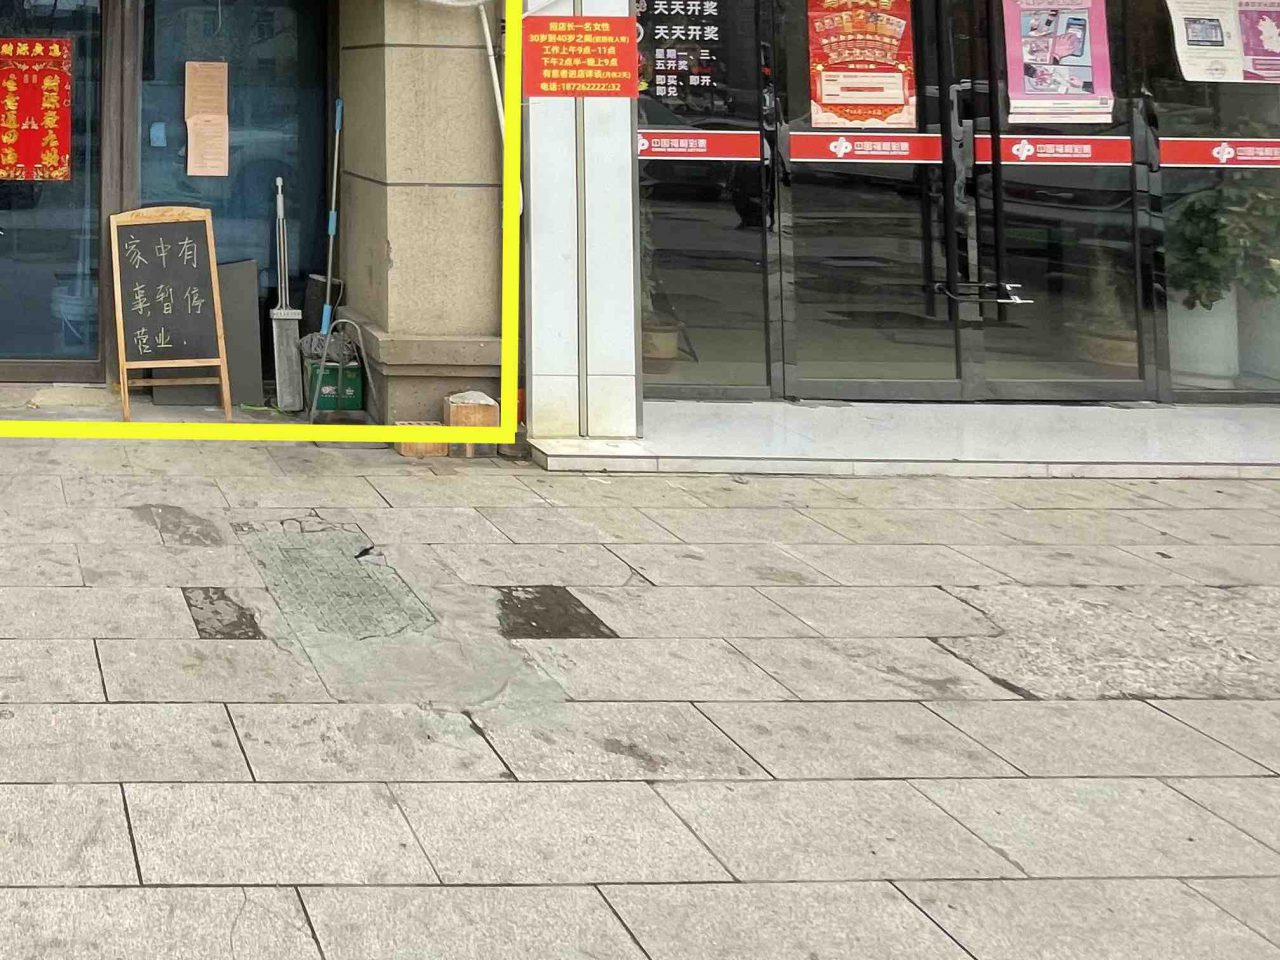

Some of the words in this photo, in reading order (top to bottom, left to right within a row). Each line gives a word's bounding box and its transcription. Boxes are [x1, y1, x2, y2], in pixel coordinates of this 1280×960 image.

[654, 1, 718, 15] 天天开奖
[655, 26, 719, 40] 天天开奖
[655, 60, 688, 70] 五开奖
[656, 86, 678, 96] 即兑
[125, 235, 197, 269] 家中有
